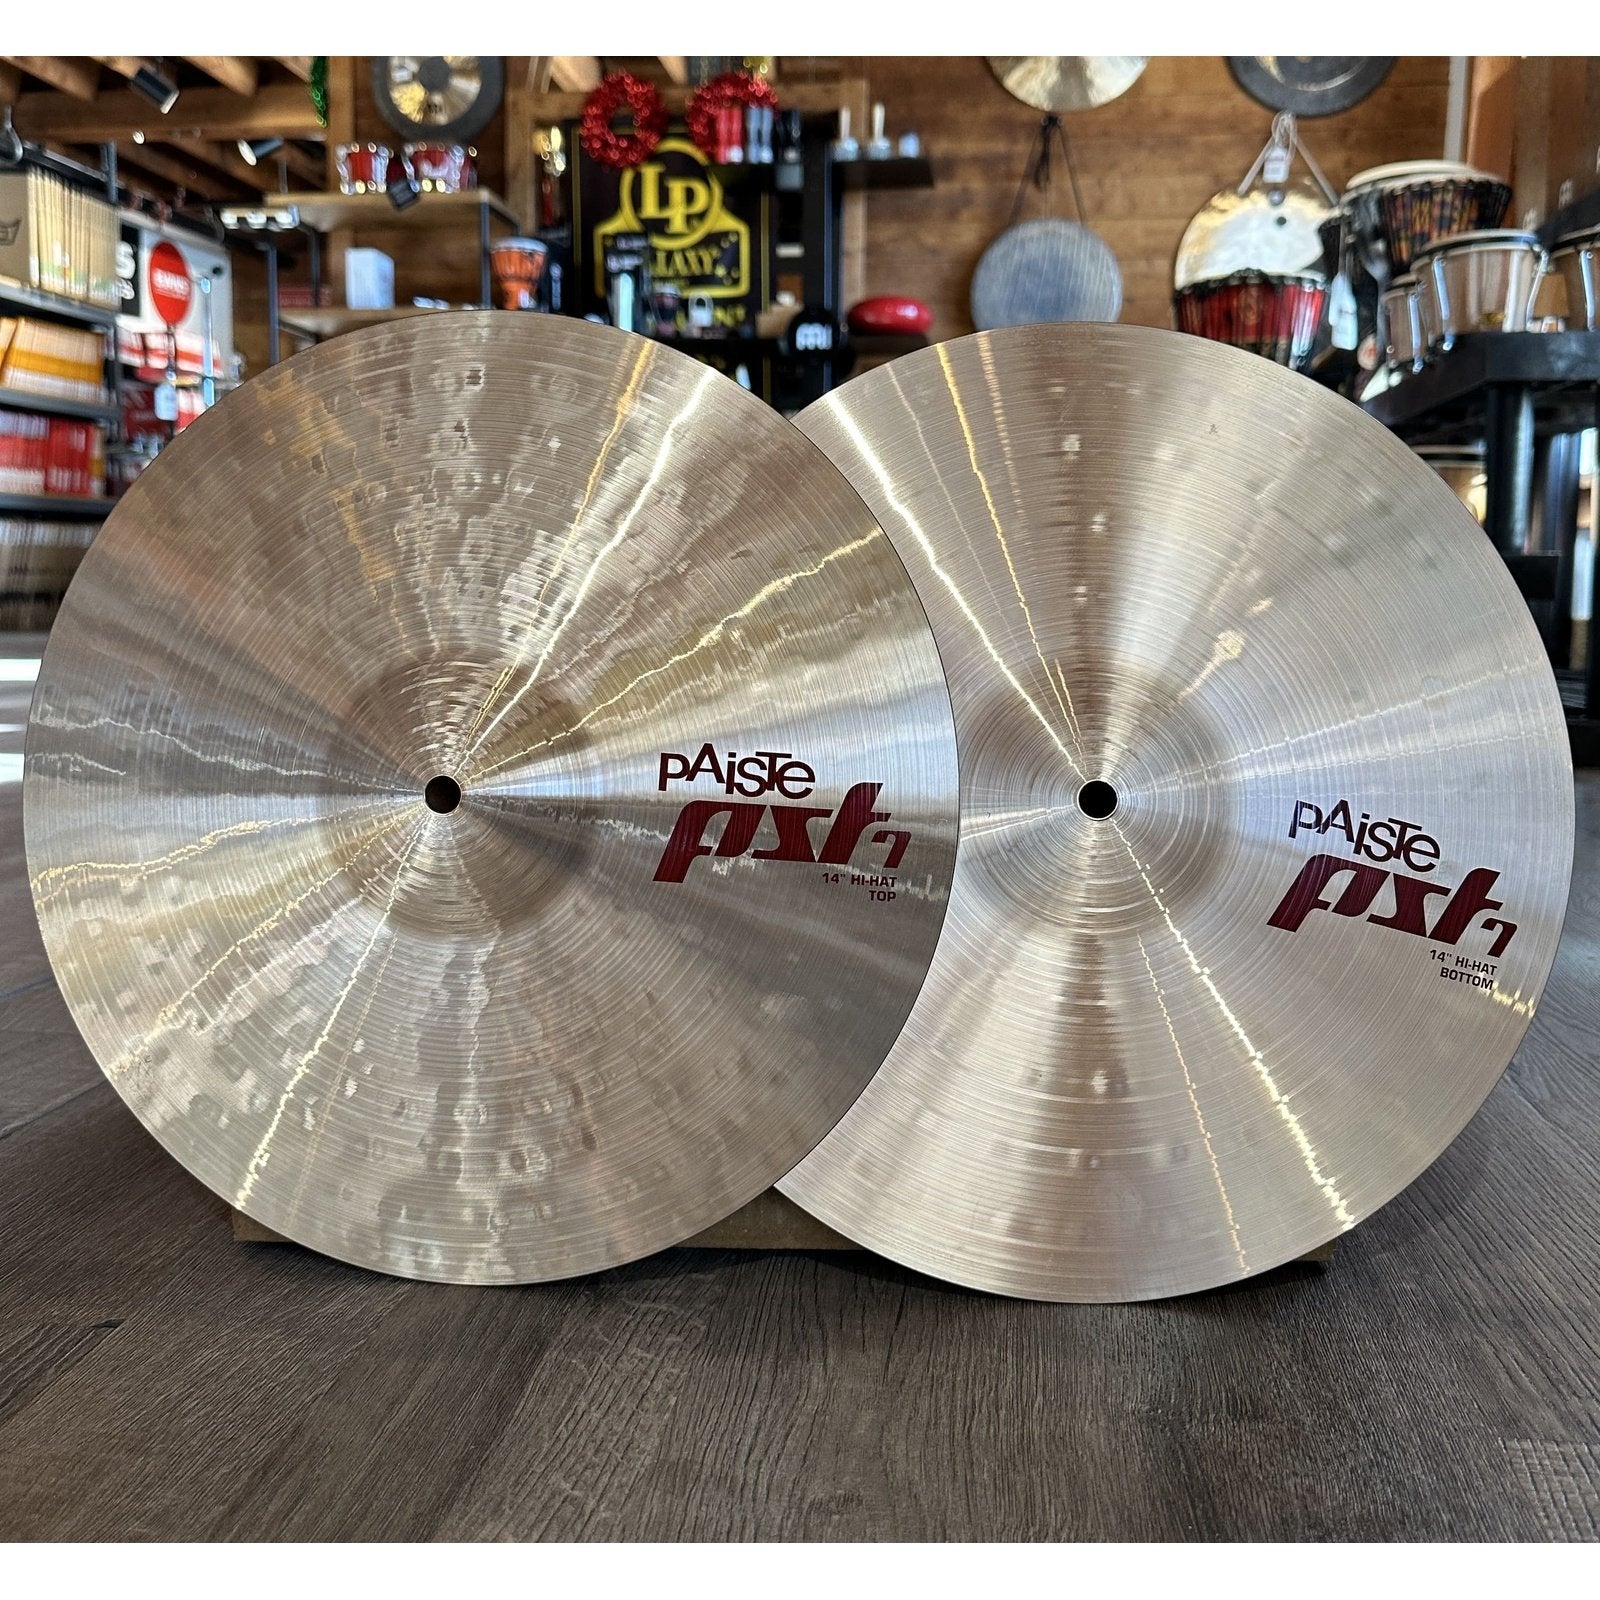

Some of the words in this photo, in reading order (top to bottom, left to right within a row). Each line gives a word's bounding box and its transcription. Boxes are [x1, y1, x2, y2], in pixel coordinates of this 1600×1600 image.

[638, 163, 711, 235] LP
[822, 872, 846, 884] 14"
[851, 874, 898, 888] HI-HAT
[868, 889, 897, 902] TOP
[1429, 949, 1452, 962] 14"
[1455, 955, 1498, 976] HI-HAT
[1440, 966, 1494, 990] BOTTOM
